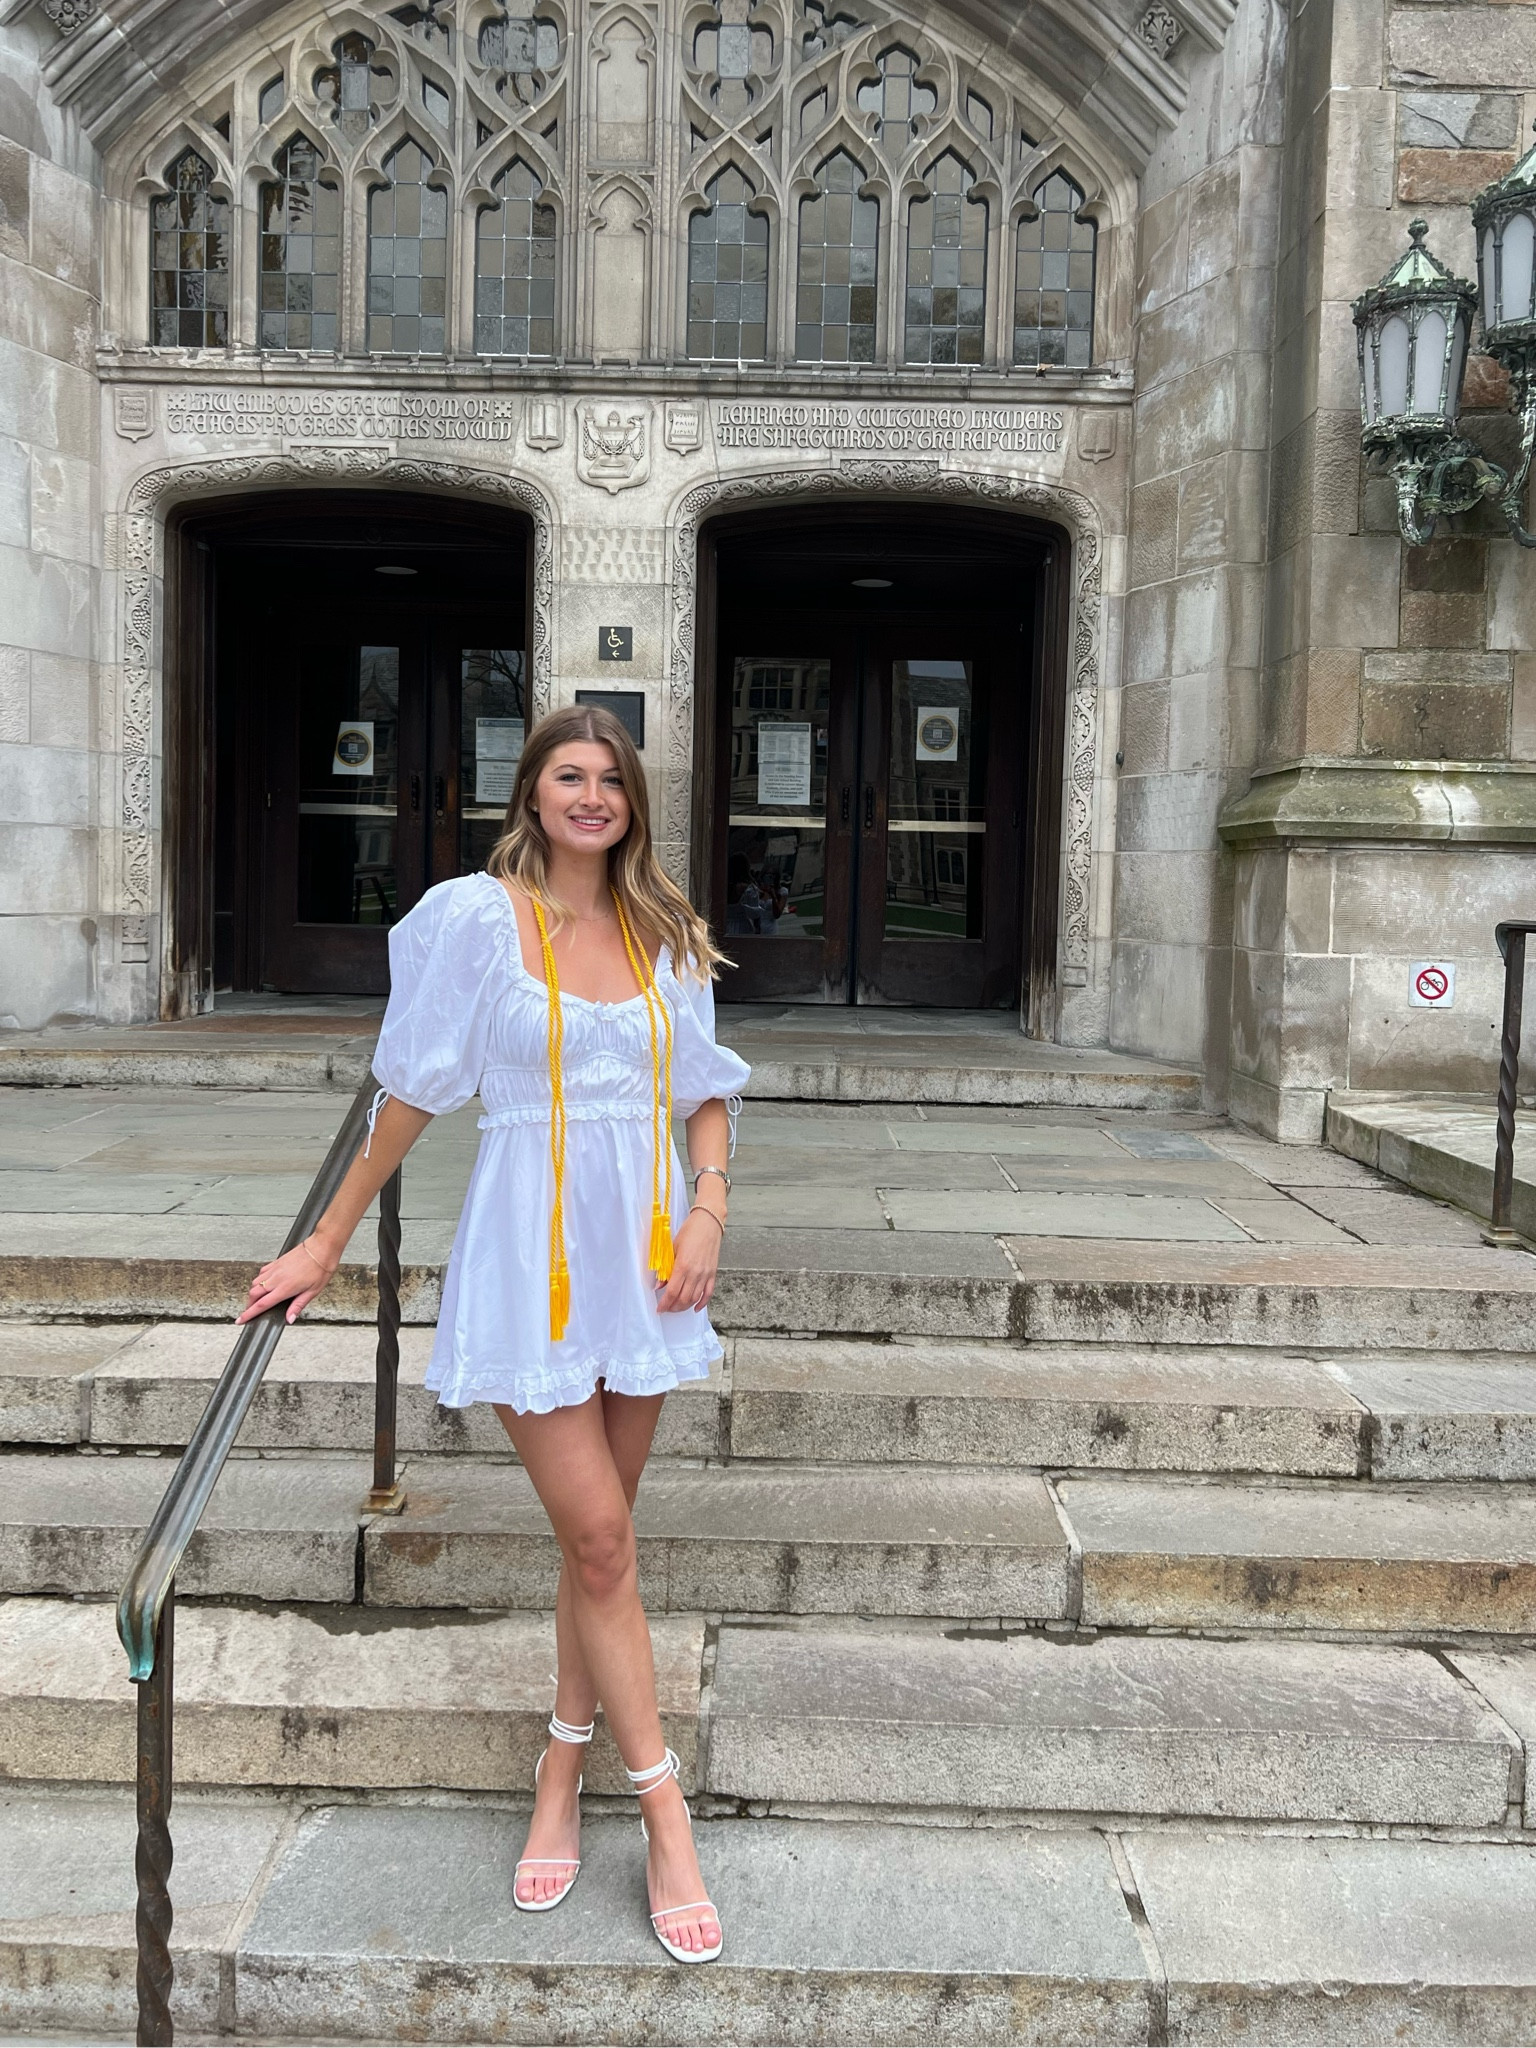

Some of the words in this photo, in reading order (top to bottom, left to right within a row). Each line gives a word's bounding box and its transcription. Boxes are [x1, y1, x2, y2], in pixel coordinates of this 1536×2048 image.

[190, 393, 231, 412] LAW
[233, 393, 334, 415] EMBODIES
[377, 396, 459, 418] WISDOM
[463, 398, 490, 418] OF
[360, 417, 430, 439] COMES
[433, 419, 512, 441] SLOWLY
[717, 405, 808, 426] LEARNED
[812, 406, 852, 427] AND
[856, 407, 967, 429] CULTURED
[970, 410, 1063, 431] LAWYERS
[763, 427, 886, 449] SAFEGUARDS
[888, 430, 915, 450] OF
